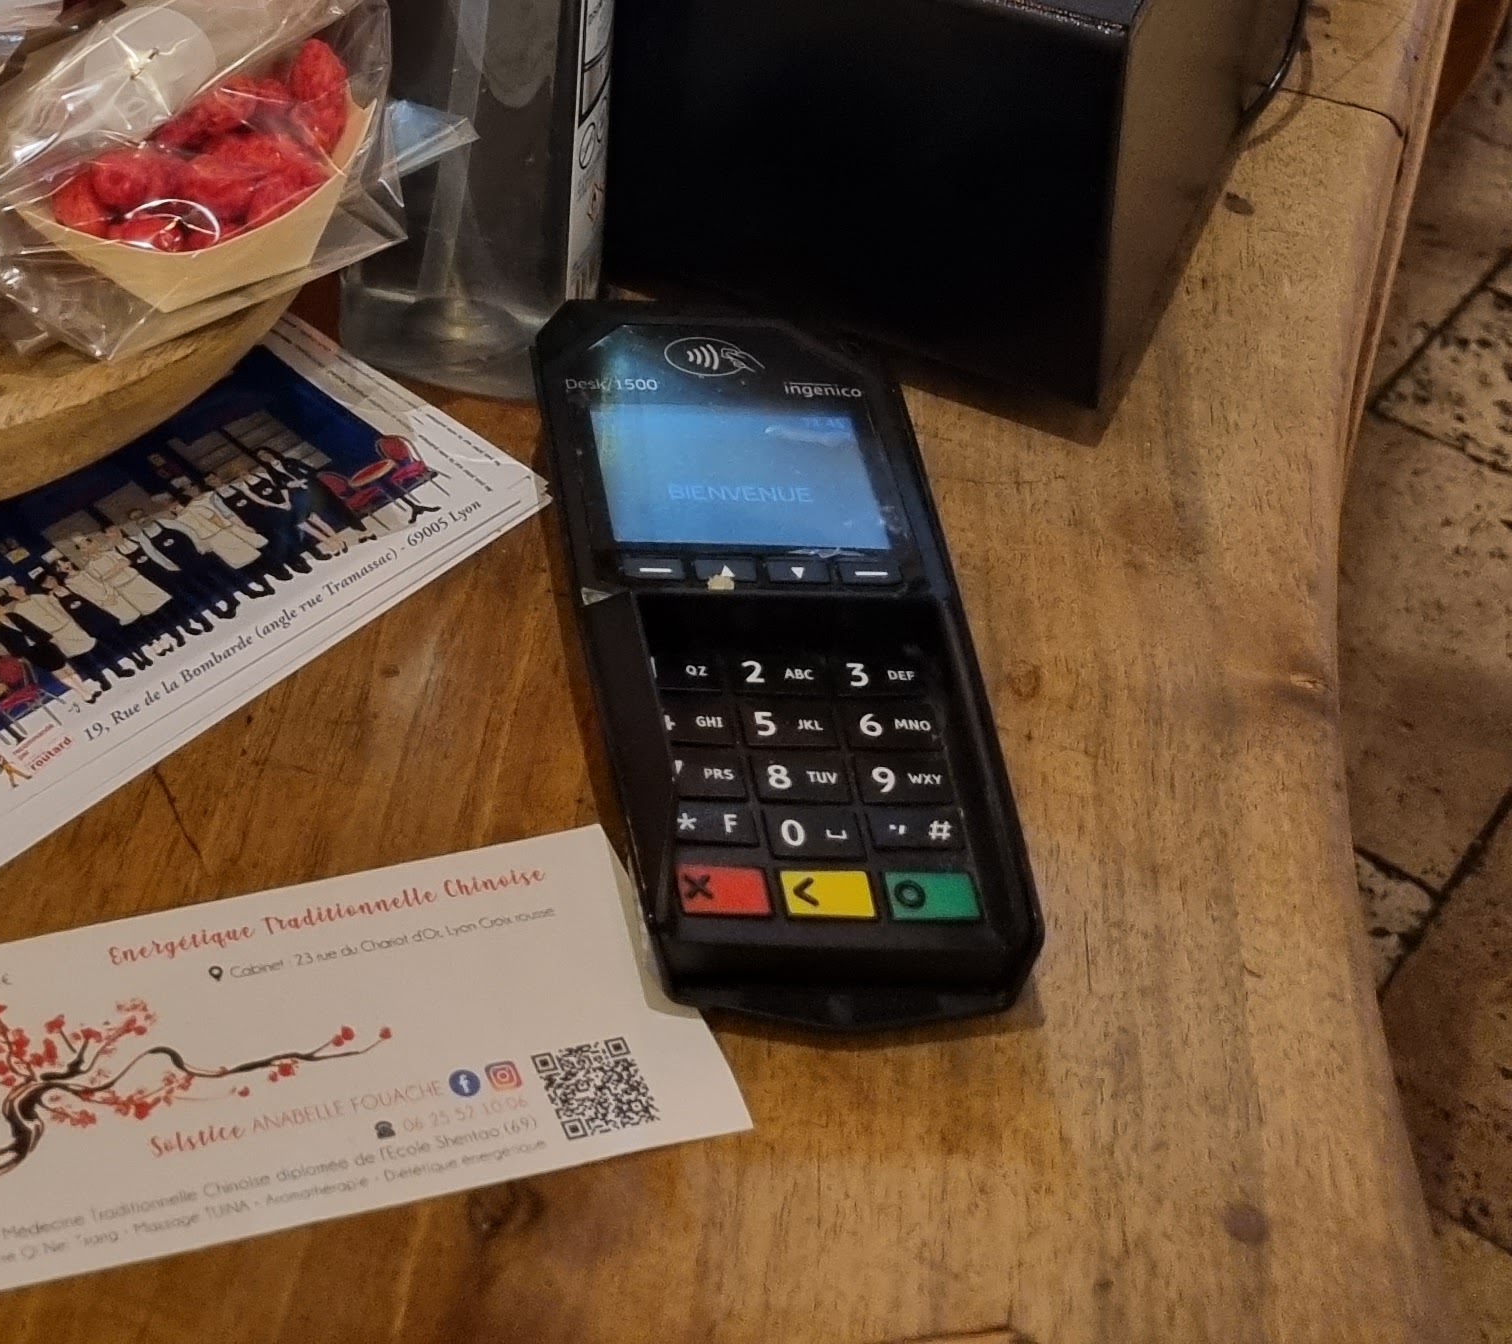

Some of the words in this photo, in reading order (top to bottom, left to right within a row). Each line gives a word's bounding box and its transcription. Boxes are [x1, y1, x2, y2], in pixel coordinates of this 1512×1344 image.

[564, 376, 659, 392] Desk/1500
[783, 382, 863, 399] ingenico
[667, 484, 816, 505] BIENVENUE
[82, 722, 112, 746] 19,
[111, 703, 143, 729] Rue
[143, 689, 163, 708] de
[162, 675, 182, 698] la
[180, 634, 256, 686] Bombarde
[254, 613, 300, 649] (angle
[299, 592, 325, 614] rue
[321, 547, 400, 600] Tramassac)
[405, 517, 452, 550] 69005
[449, 498, 484, 527] Lyon
[740, 660, 767, 685] 2
[784, 667, 816, 682] ABC
[845, 662, 870, 688] 3
[887, 669, 916, 683] DEF
[695, 715, 724, 729] GHI
[753, 710, 778, 738] 5
[797, 719, 825, 733] JKL
[858, 712, 884, 738] 6
[893, 718, 932, 733] MNO
[30, 736, 73, 772] routard
[703, 767, 735, 781] PRS
[766, 764, 793, 790] 8
[805, 770, 839, 785] TUV
[871, 765, 897, 794] 9
[907, 772, 943, 786] WXY
[722, 813, 738, 834] F
[780, 818, 806, 847] 0
[107, 923, 256, 967] Energétique
[263, 886, 438, 936] Traditionnelle
[443, 867, 546, 899] Chinoise
[229, 958, 285, 979] Cabinet
[294, 953, 314, 968] 23
[317, 949, 338, 963] rue
[340, 945, 359, 958] du
[359, 934, 410, 954] Chariot
[446, 920, 478, 940] Lyon
[478, 911, 514, 931] Croix
[148, 1123, 247, 1160] Solstice
[249, 1099, 345, 1134] ANABELLE
[349, 1079, 446, 1114] FOUACHE
[402, 1116, 425, 1134] 06
[0, 1212, 87, 1243] Médecine
[89, 1187, 199, 1223] Traditionnelle
[202, 1171, 271, 1200] Chinoise
[353, 1149, 376, 1167] de
[435, 1124, 501, 1150] Shentao
[502, 1115, 539, 1136] (69)
